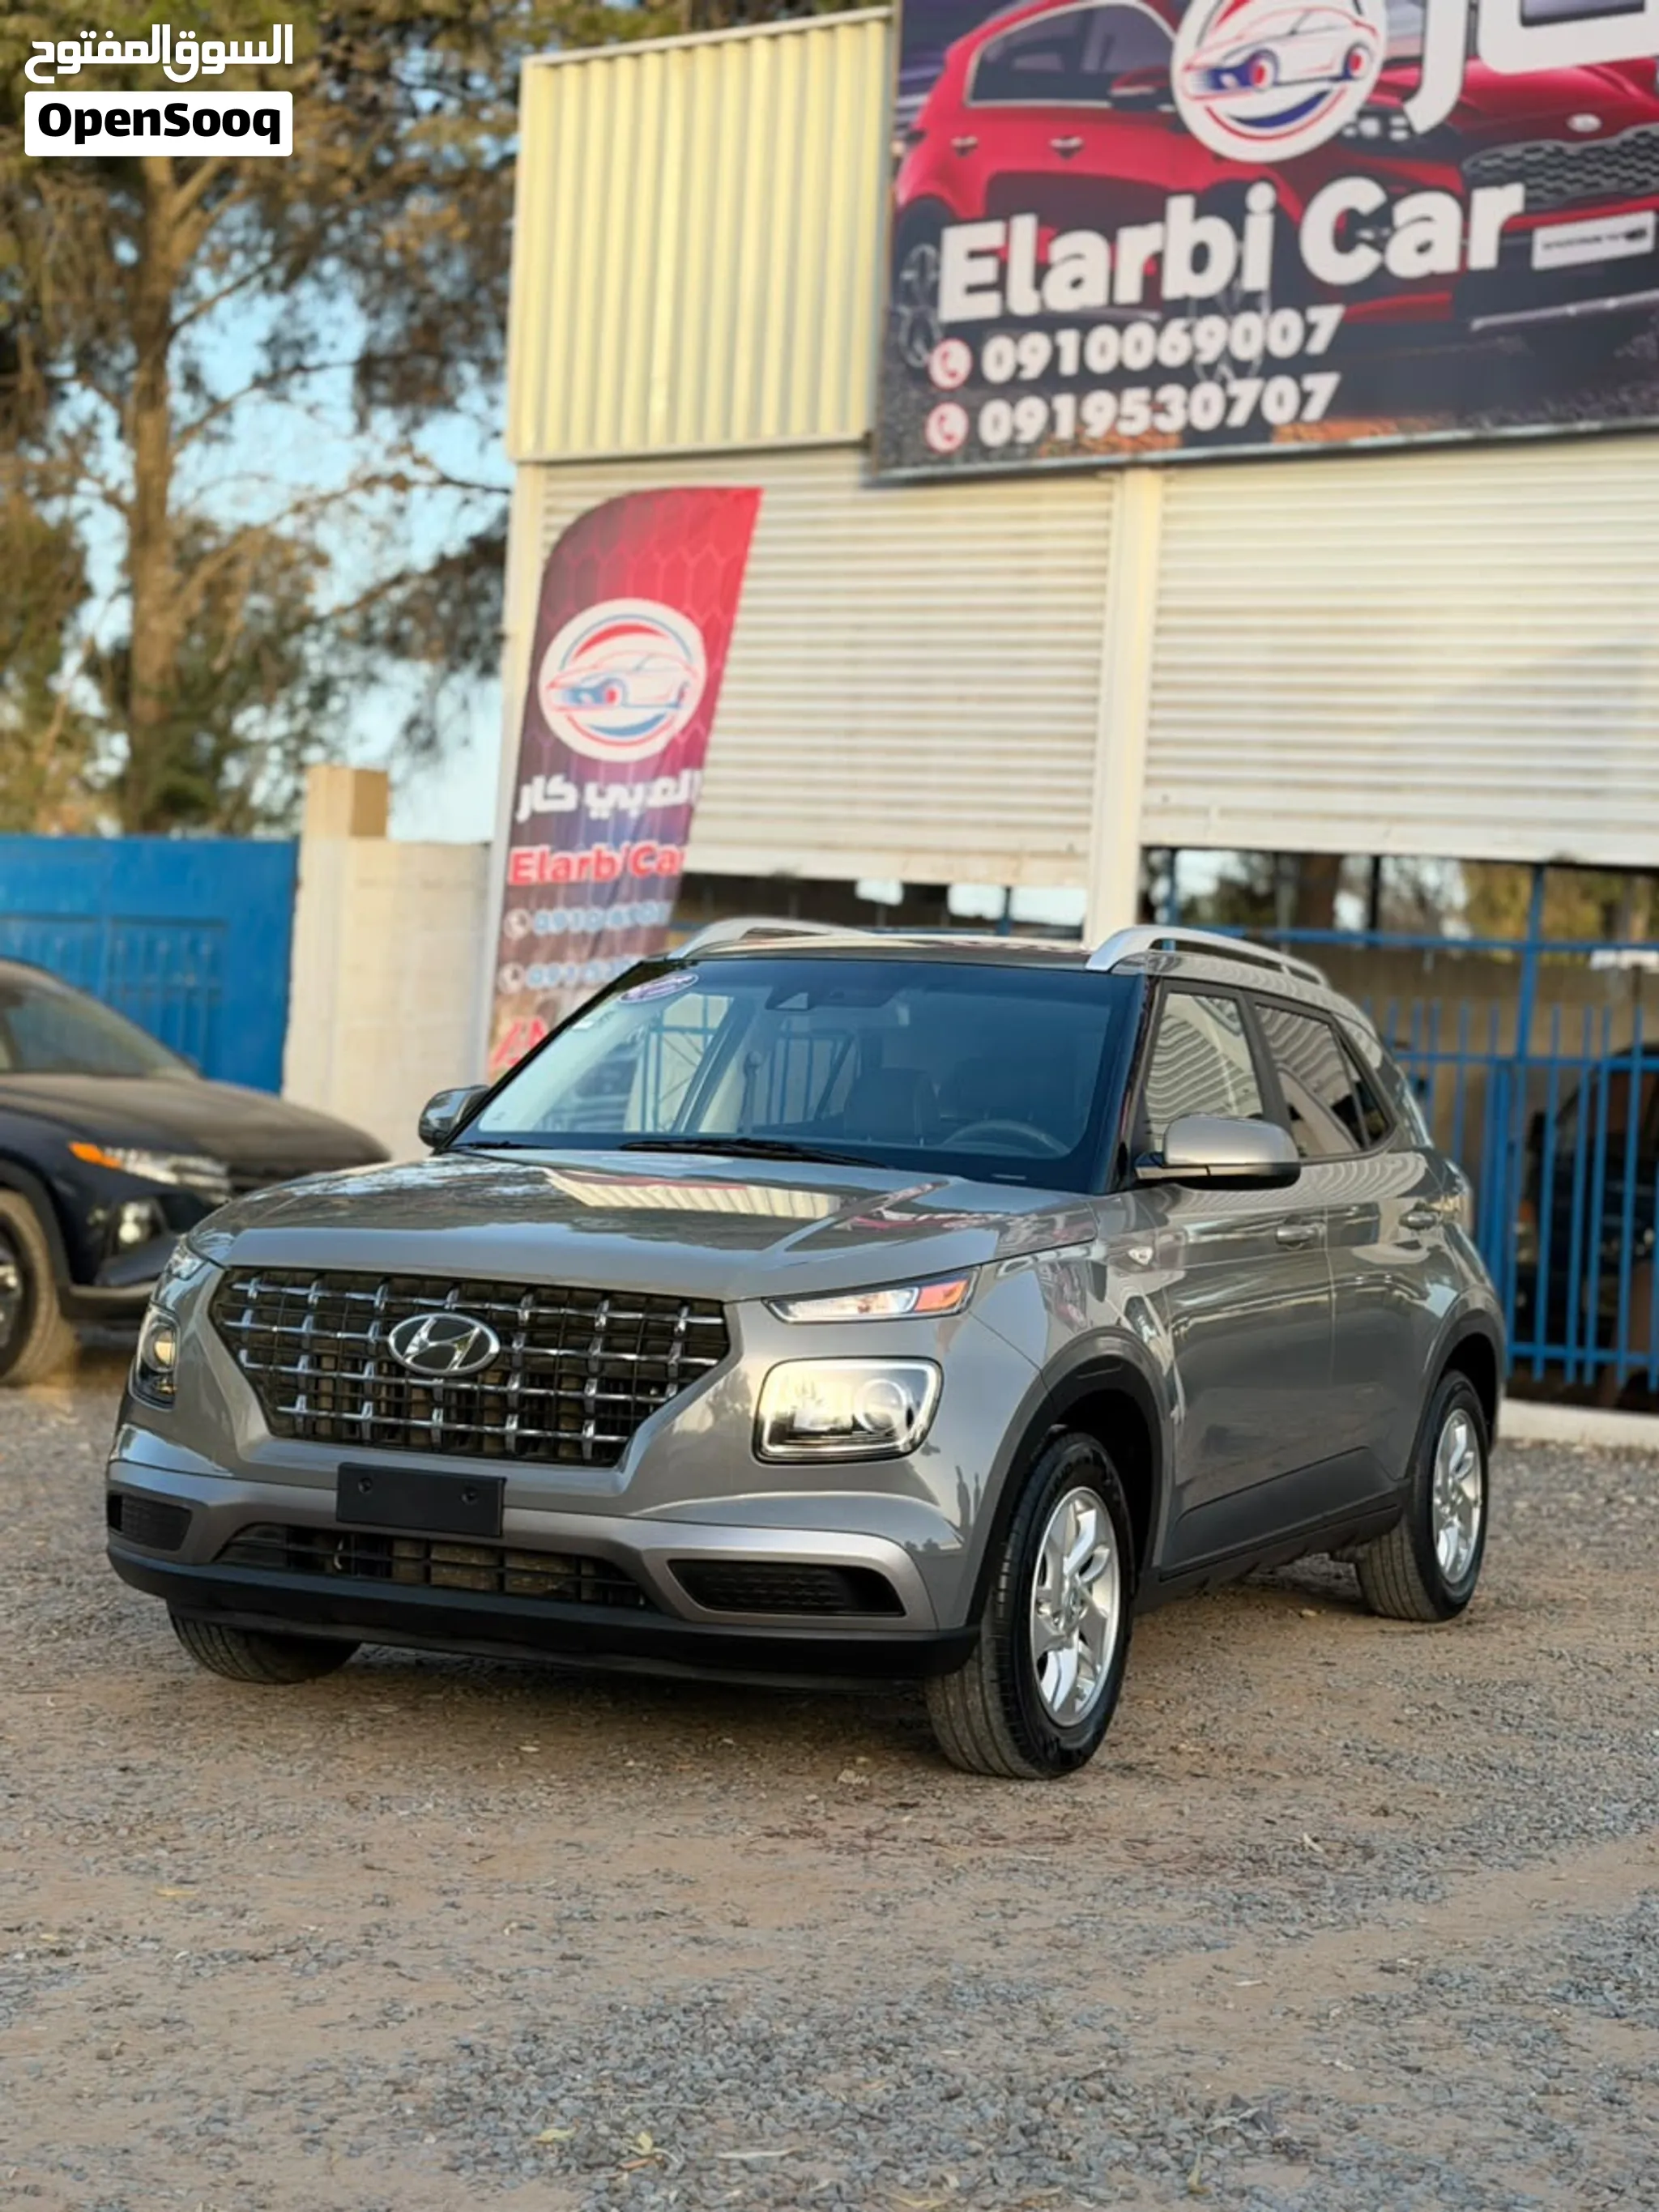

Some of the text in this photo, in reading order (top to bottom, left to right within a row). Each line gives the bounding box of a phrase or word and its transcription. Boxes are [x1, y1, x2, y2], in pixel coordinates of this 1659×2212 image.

[939, 176, 1525, 322] Elarbi Car
[981, 305, 1346, 384] 0910069007
[978, 372, 1341, 448] 0919530707
[516, 771, 579, 825] كار
[508, 839, 686, 885] Elarb Ca
